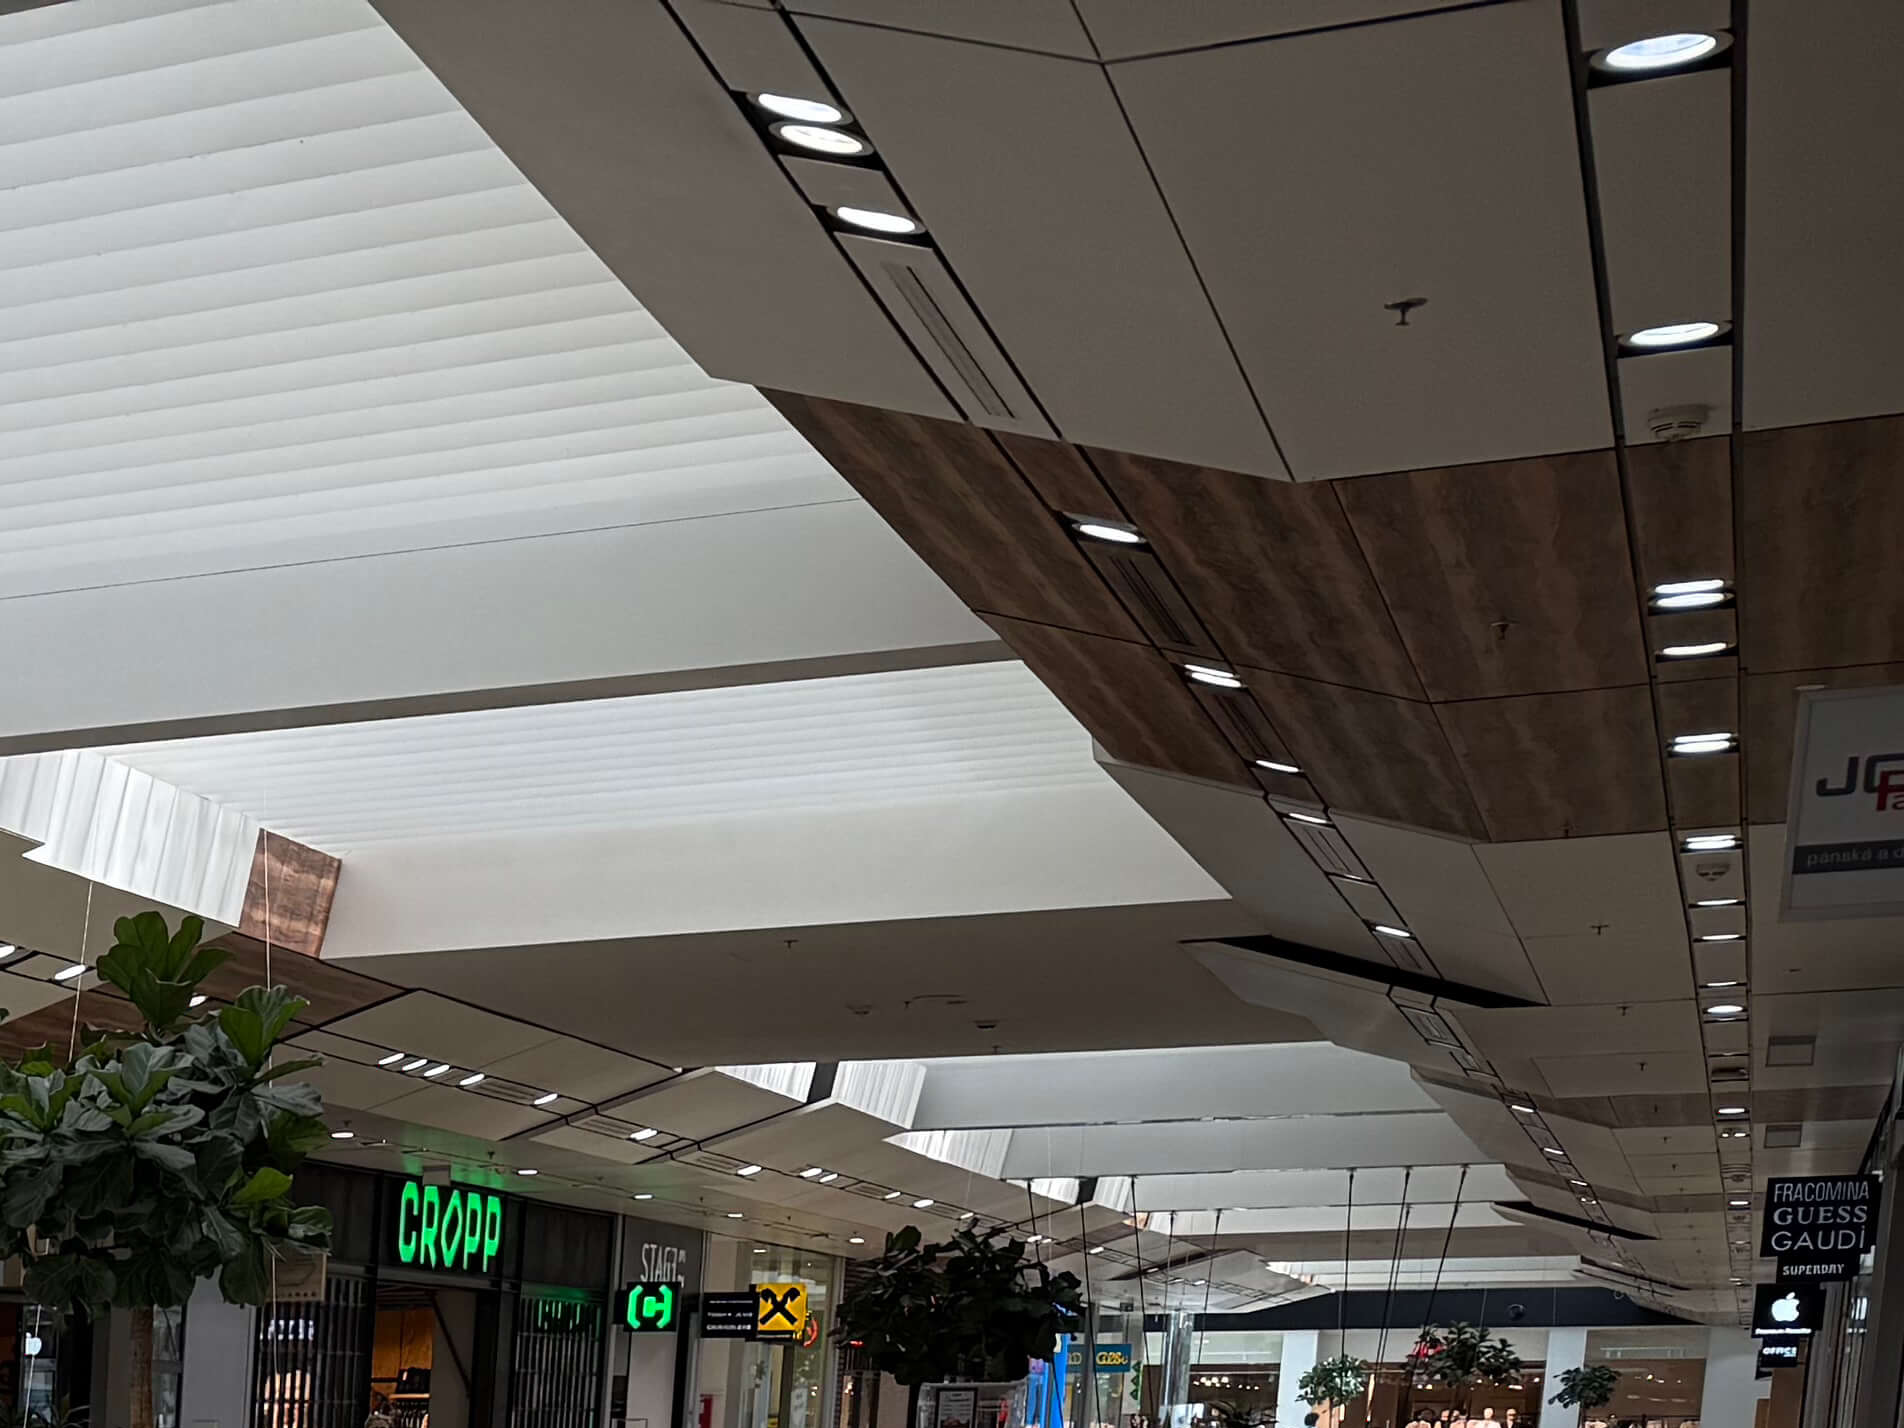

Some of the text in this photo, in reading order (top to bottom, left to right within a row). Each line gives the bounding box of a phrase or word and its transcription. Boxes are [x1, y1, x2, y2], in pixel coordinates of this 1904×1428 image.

[1773, 1181, 1870, 1203] FRACOMINA
[1773, 1205, 1868, 1225] GUESS
[397, 1181, 502, 1273] CROPP
